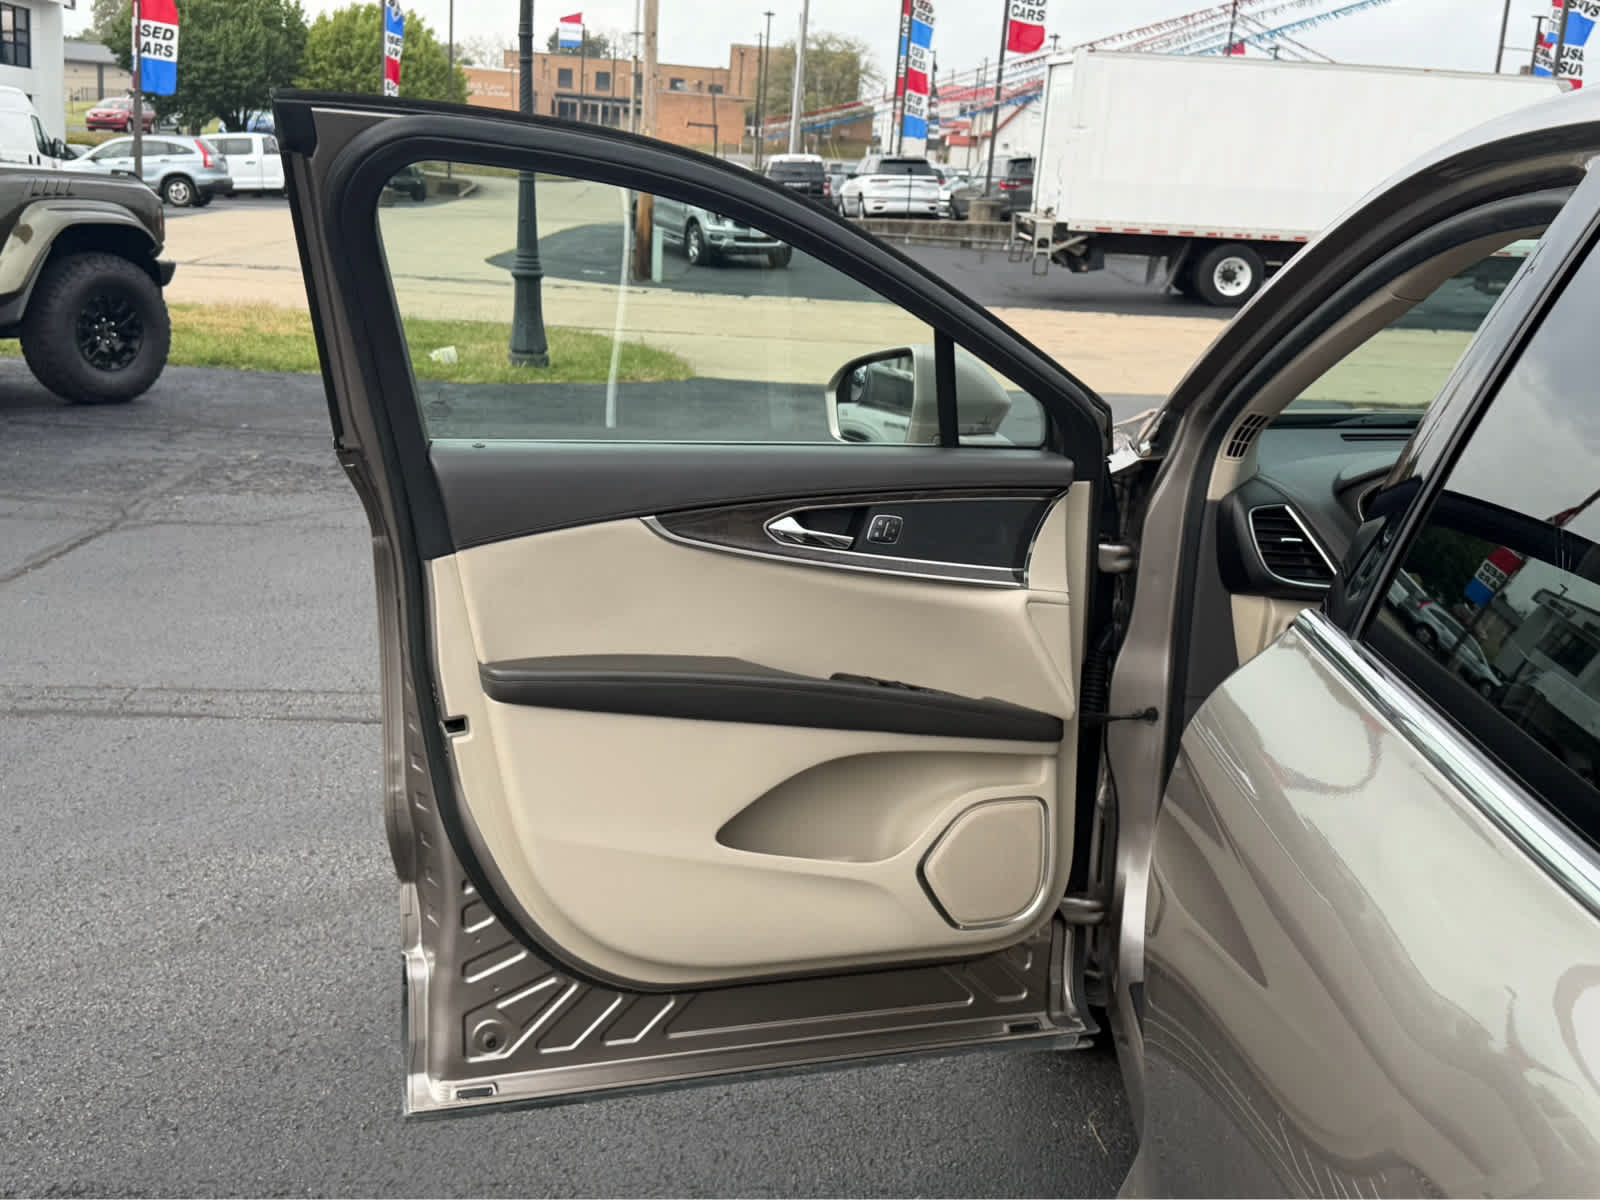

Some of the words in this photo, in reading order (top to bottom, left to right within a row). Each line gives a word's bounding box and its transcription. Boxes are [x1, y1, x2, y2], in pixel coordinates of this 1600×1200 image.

[1011, 4, 1046, 22] CARS
[140, 24, 175, 41] SED
[141, 41, 174, 58] ARS
